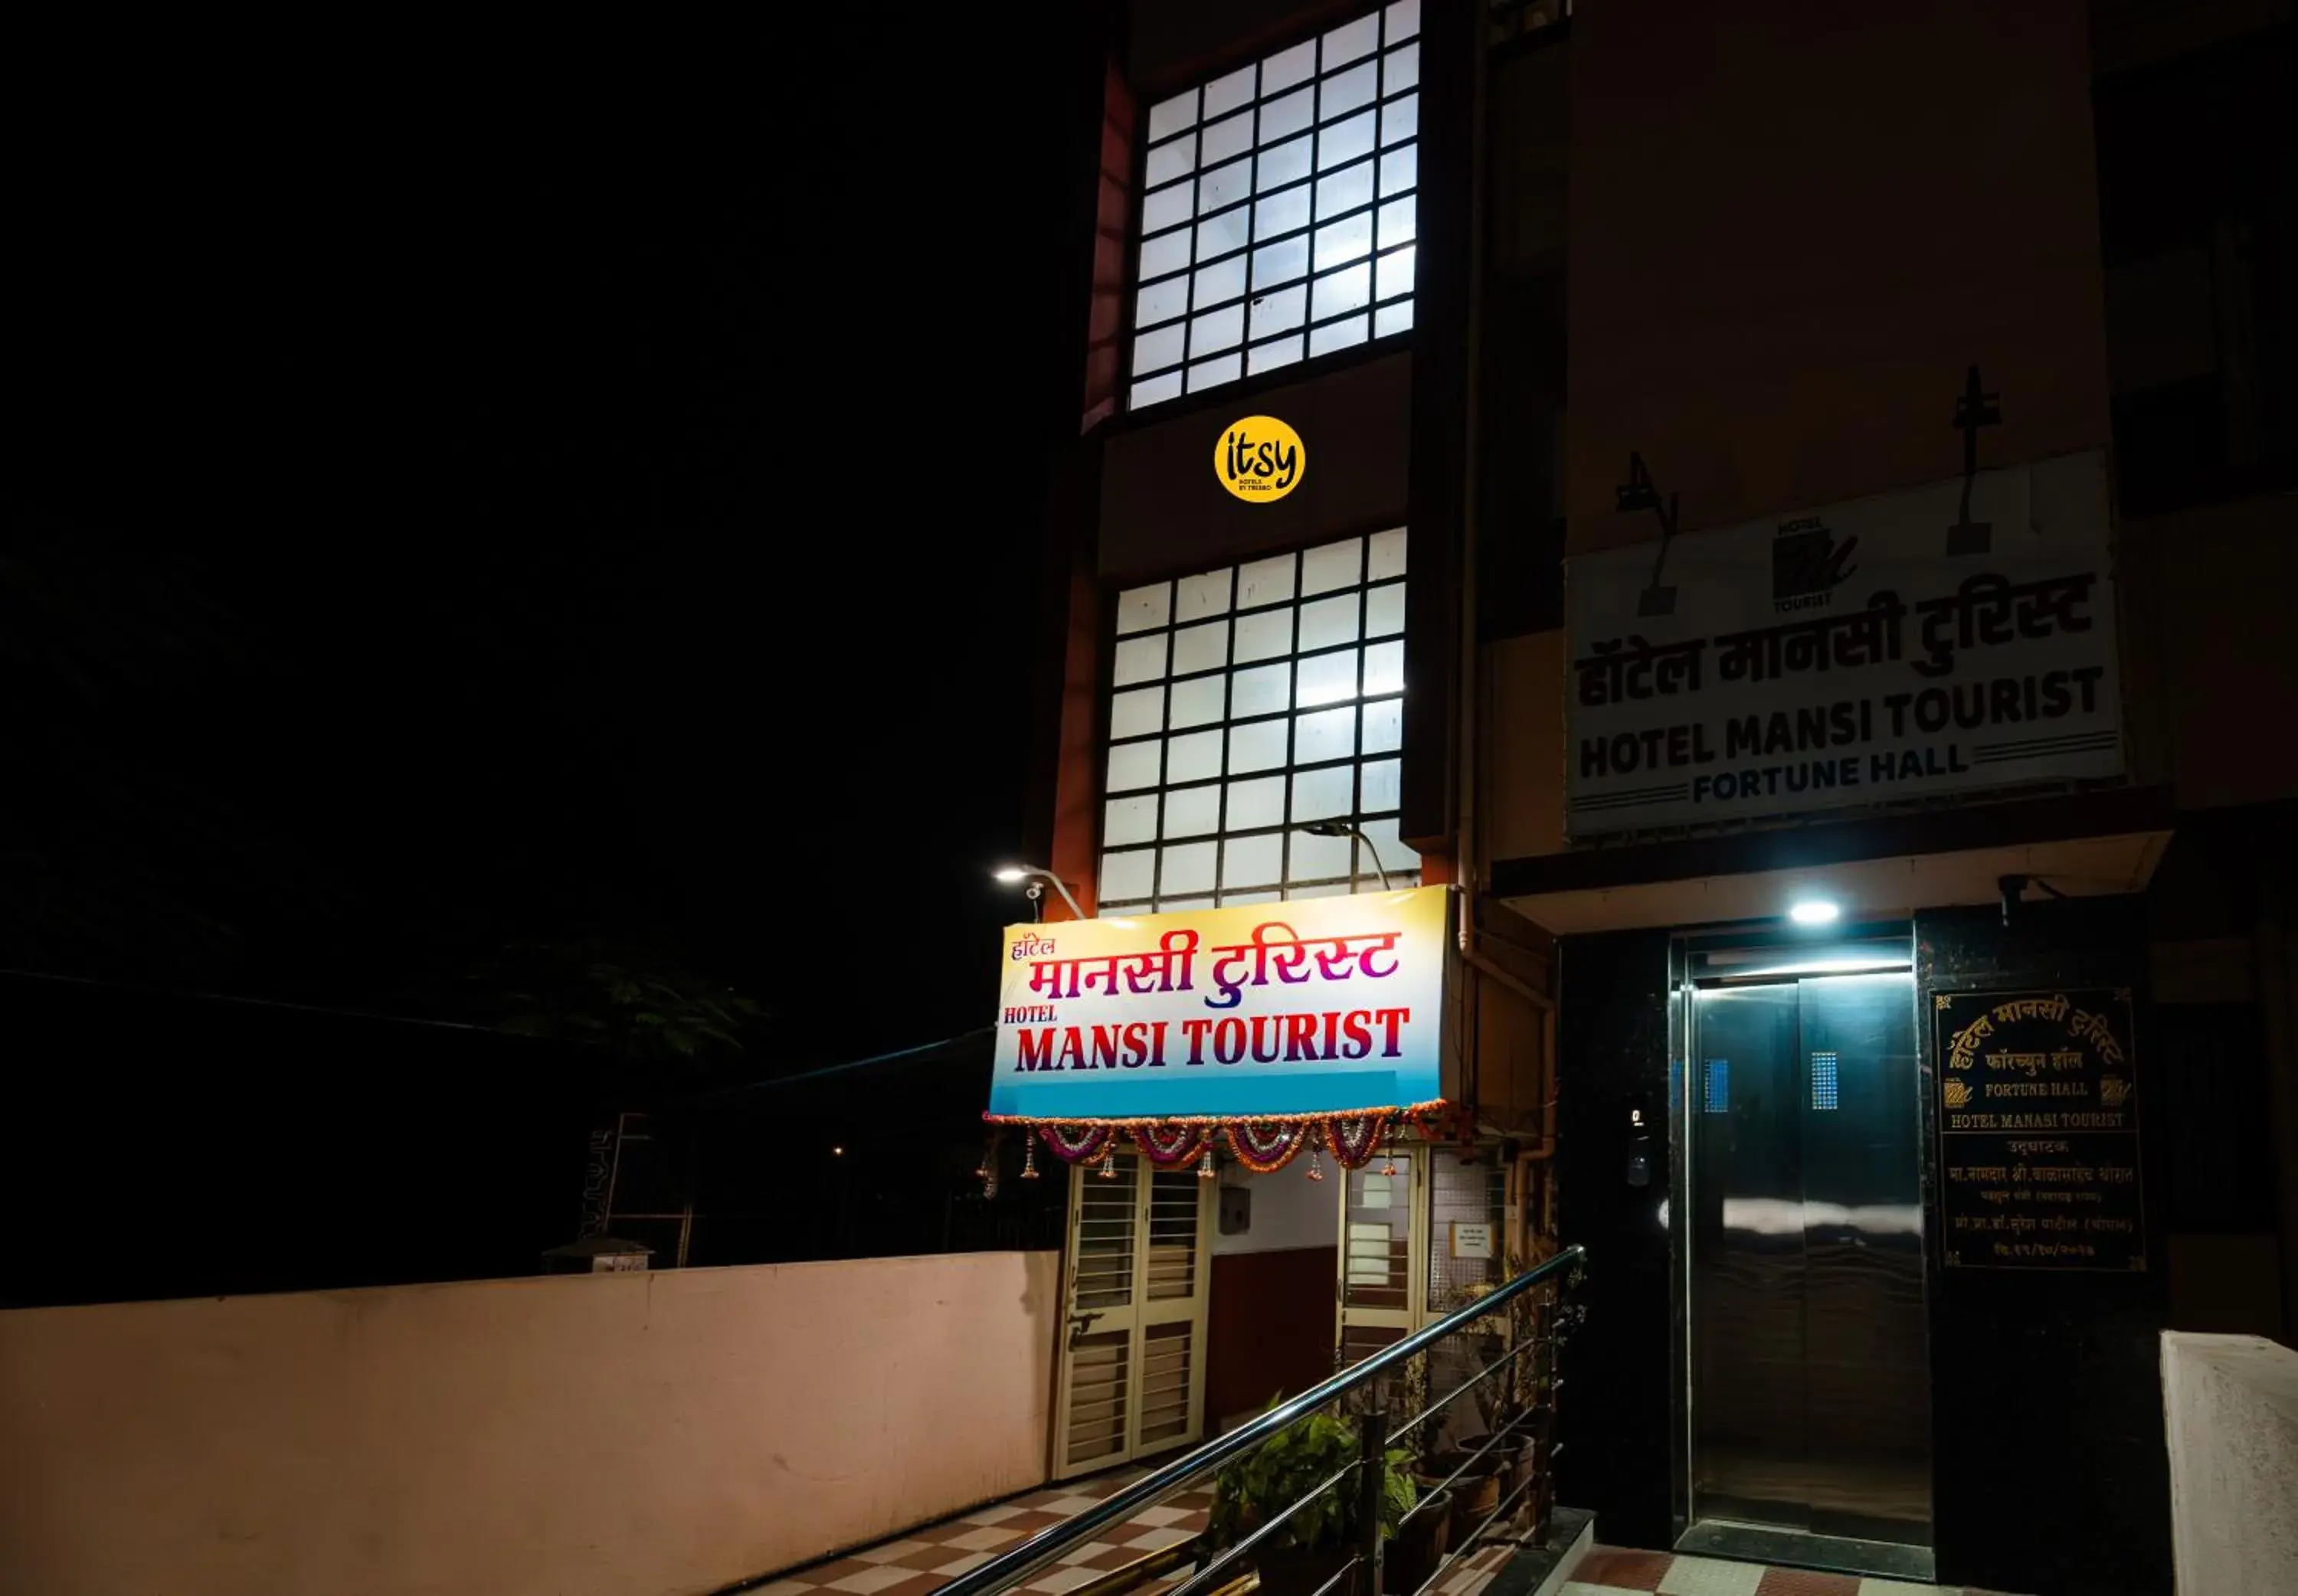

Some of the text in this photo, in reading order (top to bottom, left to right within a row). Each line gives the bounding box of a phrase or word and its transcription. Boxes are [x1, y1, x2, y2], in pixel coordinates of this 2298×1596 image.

[1227, 431, 1296, 489] itsy
[1714, 590, 1907, 682] मानसी
[1910, 573, 2097, 678] टुरिस्ट
[1774, 592, 1834, 613] TOURIST
[1580, 666, 2103, 778] HOTEL MANSI TOURIST
[1693, 744, 1969, 803] FORTUNE HALL
[1029, 921, 1402, 1009] मानसी टुरिस्ट
[1003, 1004, 1058, 1024] HOTEL
[1992, 993, 2071, 1023] मानसी
[1015, 1007, 1411, 1072] MANSI TOURIST
[1985, 1081, 2089, 1097] FORTUNE HALL
[1951, 1112, 2125, 1128] HOTEL MANASI TOURIST
